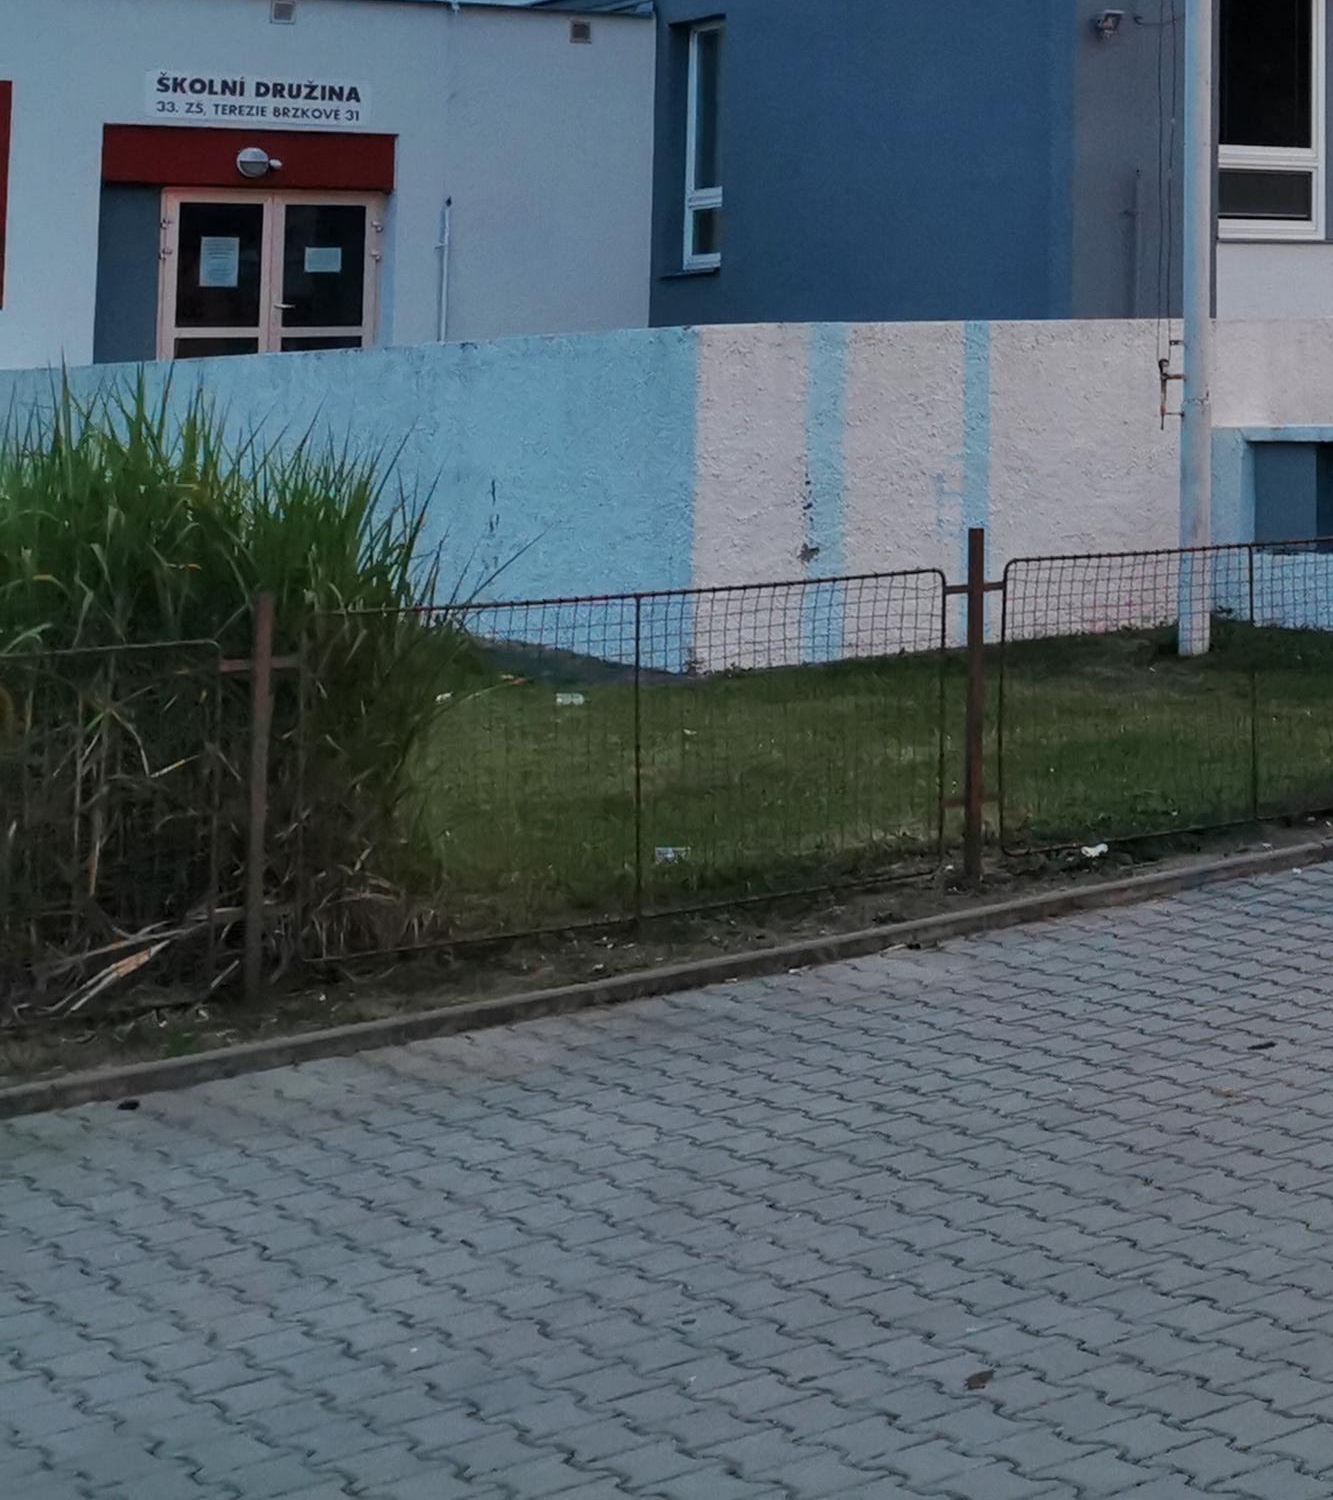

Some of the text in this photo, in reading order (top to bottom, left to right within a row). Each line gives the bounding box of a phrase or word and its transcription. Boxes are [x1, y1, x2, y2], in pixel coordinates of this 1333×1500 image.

[156, 71, 361, 103] ŠKOLNÍ DRUŽINA
[156, 100, 179, 113] 33.
[213, 102, 267, 117] TEREZIE
[344, 109, 360, 121] 31
